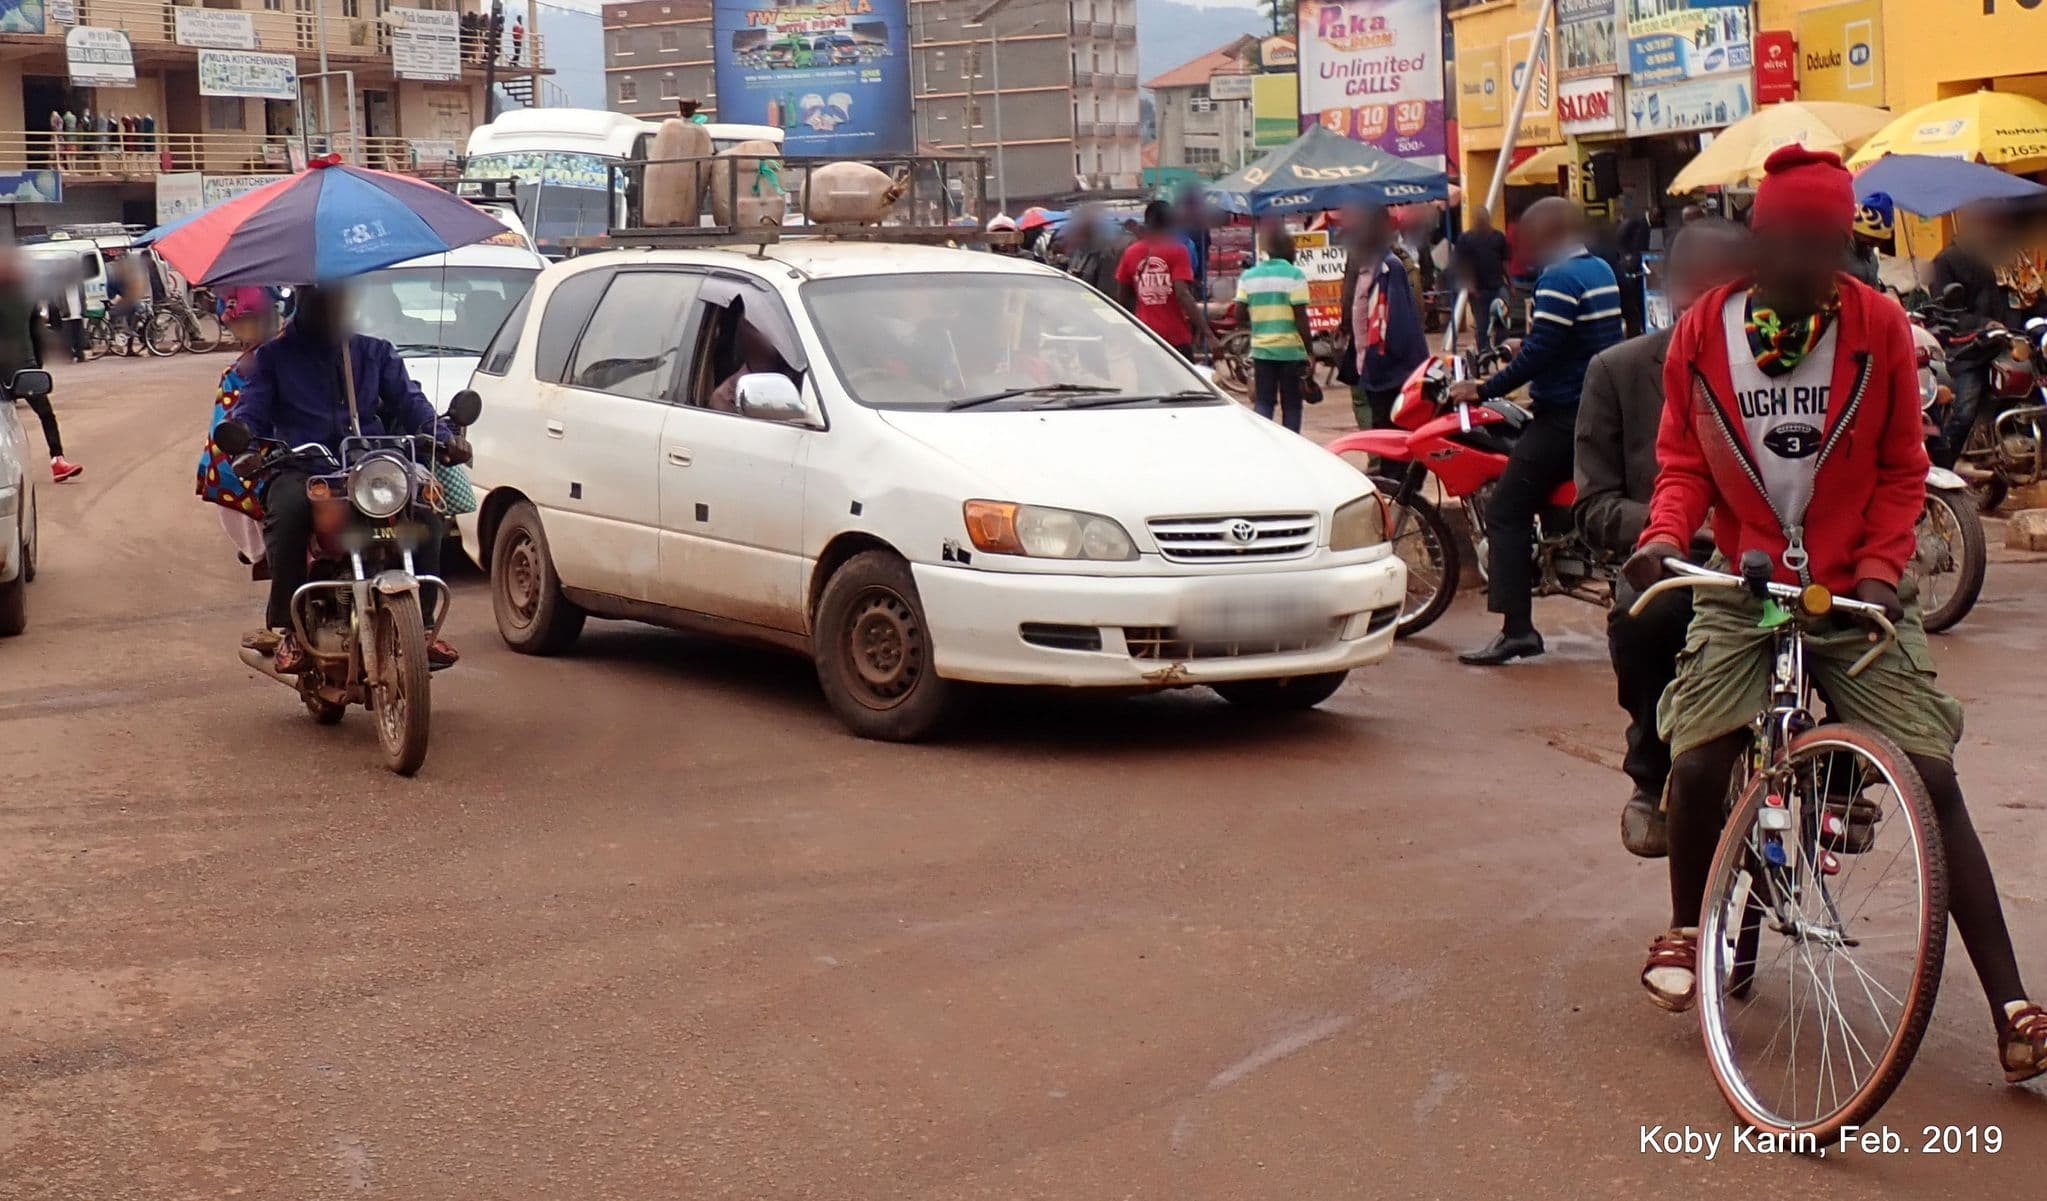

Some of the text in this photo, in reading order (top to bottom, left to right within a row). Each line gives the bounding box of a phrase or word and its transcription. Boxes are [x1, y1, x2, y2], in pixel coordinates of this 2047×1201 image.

[1318, 4, 1386, 39] Paka
[208, 53, 290, 67] MUTA KITCHENWARE
[1320, 52, 1425, 79] Unlimited
[1763, 58, 1788, 70] airtel
[1806, 50, 1841, 72] Dduuka
[1345, 75, 1402, 96] CALLS
[1361, 106, 1386, 127] 10
[1397, 102, 1426, 122] 30
[1558, 91, 1611, 121] SALON
[1327, 110, 1342, 130] 3
[212, 177, 235, 187] MUTA
[1738, 389, 1787, 419] UGH
[1787, 437, 1801, 452] 3
